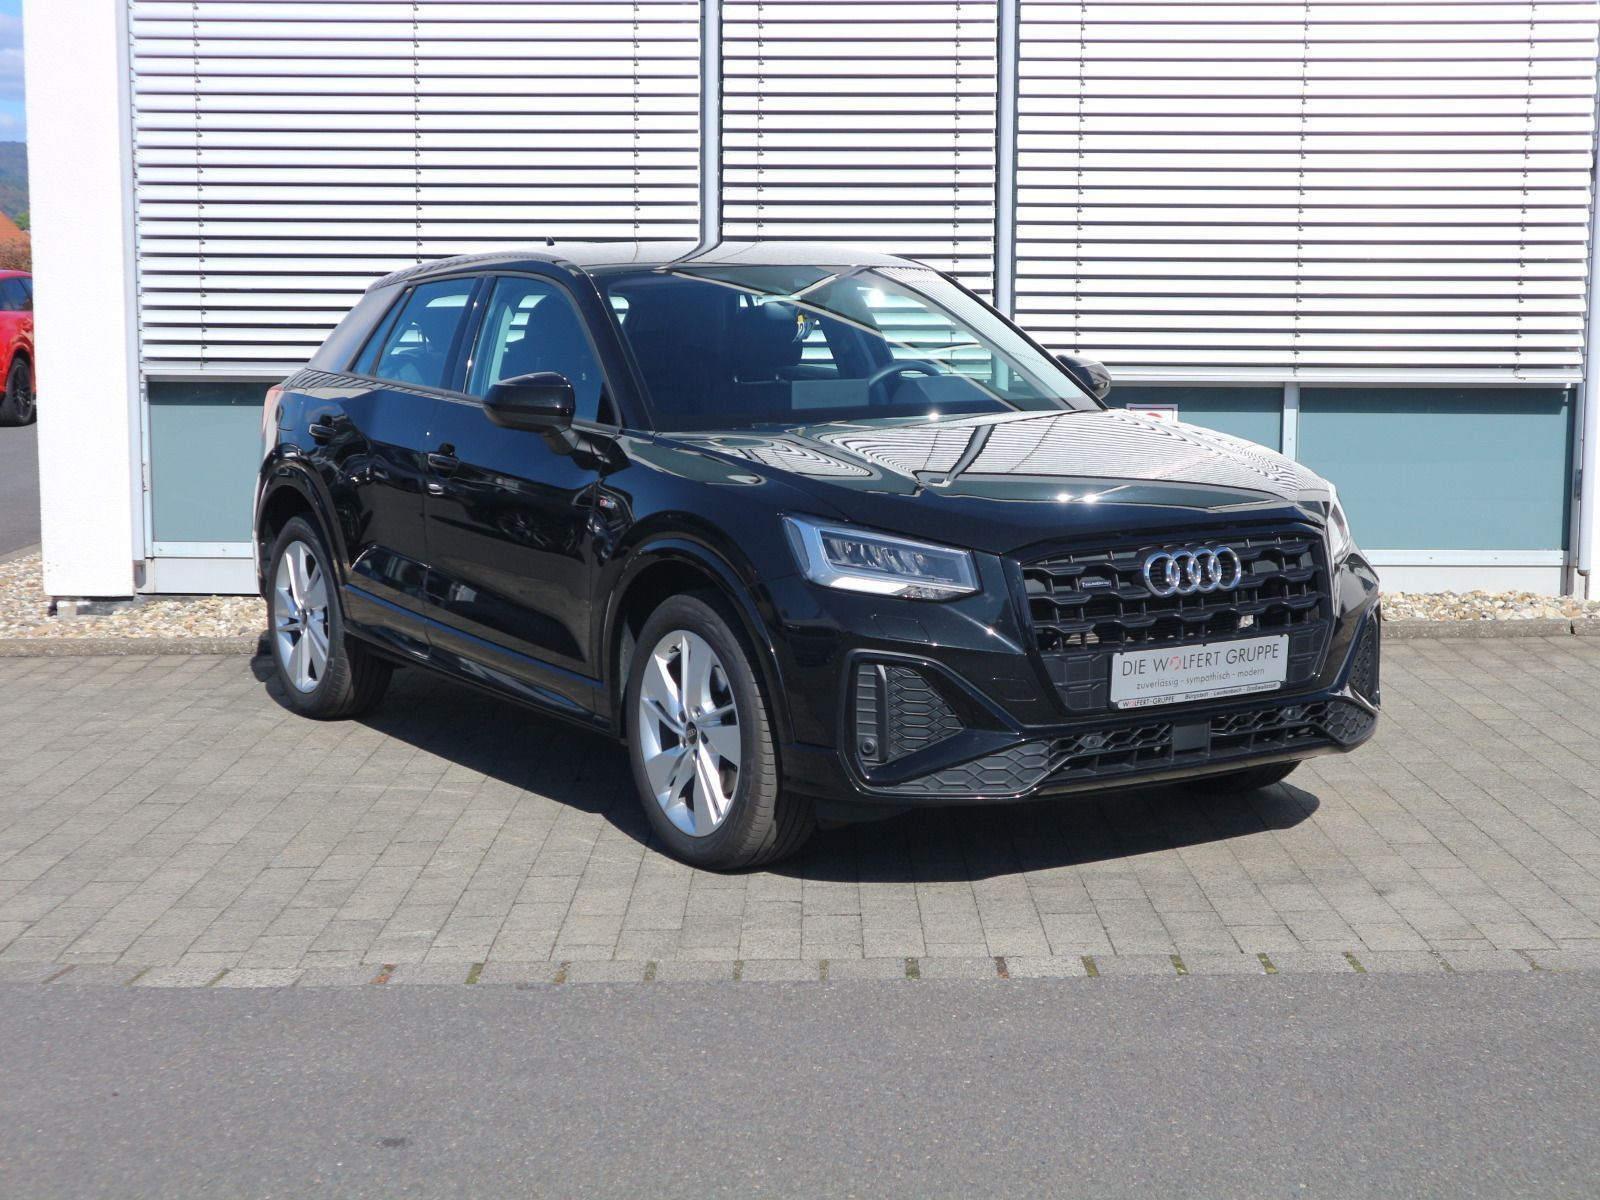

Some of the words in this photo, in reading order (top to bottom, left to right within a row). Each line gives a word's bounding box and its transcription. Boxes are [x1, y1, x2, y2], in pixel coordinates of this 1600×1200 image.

[1122, 658, 1146, 676] DIE
[1153, 651, 1221, 673] WOLFERT
[1226, 643, 1279, 665] GRUPPE
[1136, 678, 1179, 690] zuverlässig
[1186, 671, 1230, 684] sympathisch
[1237, 667, 1265, 678] modern
